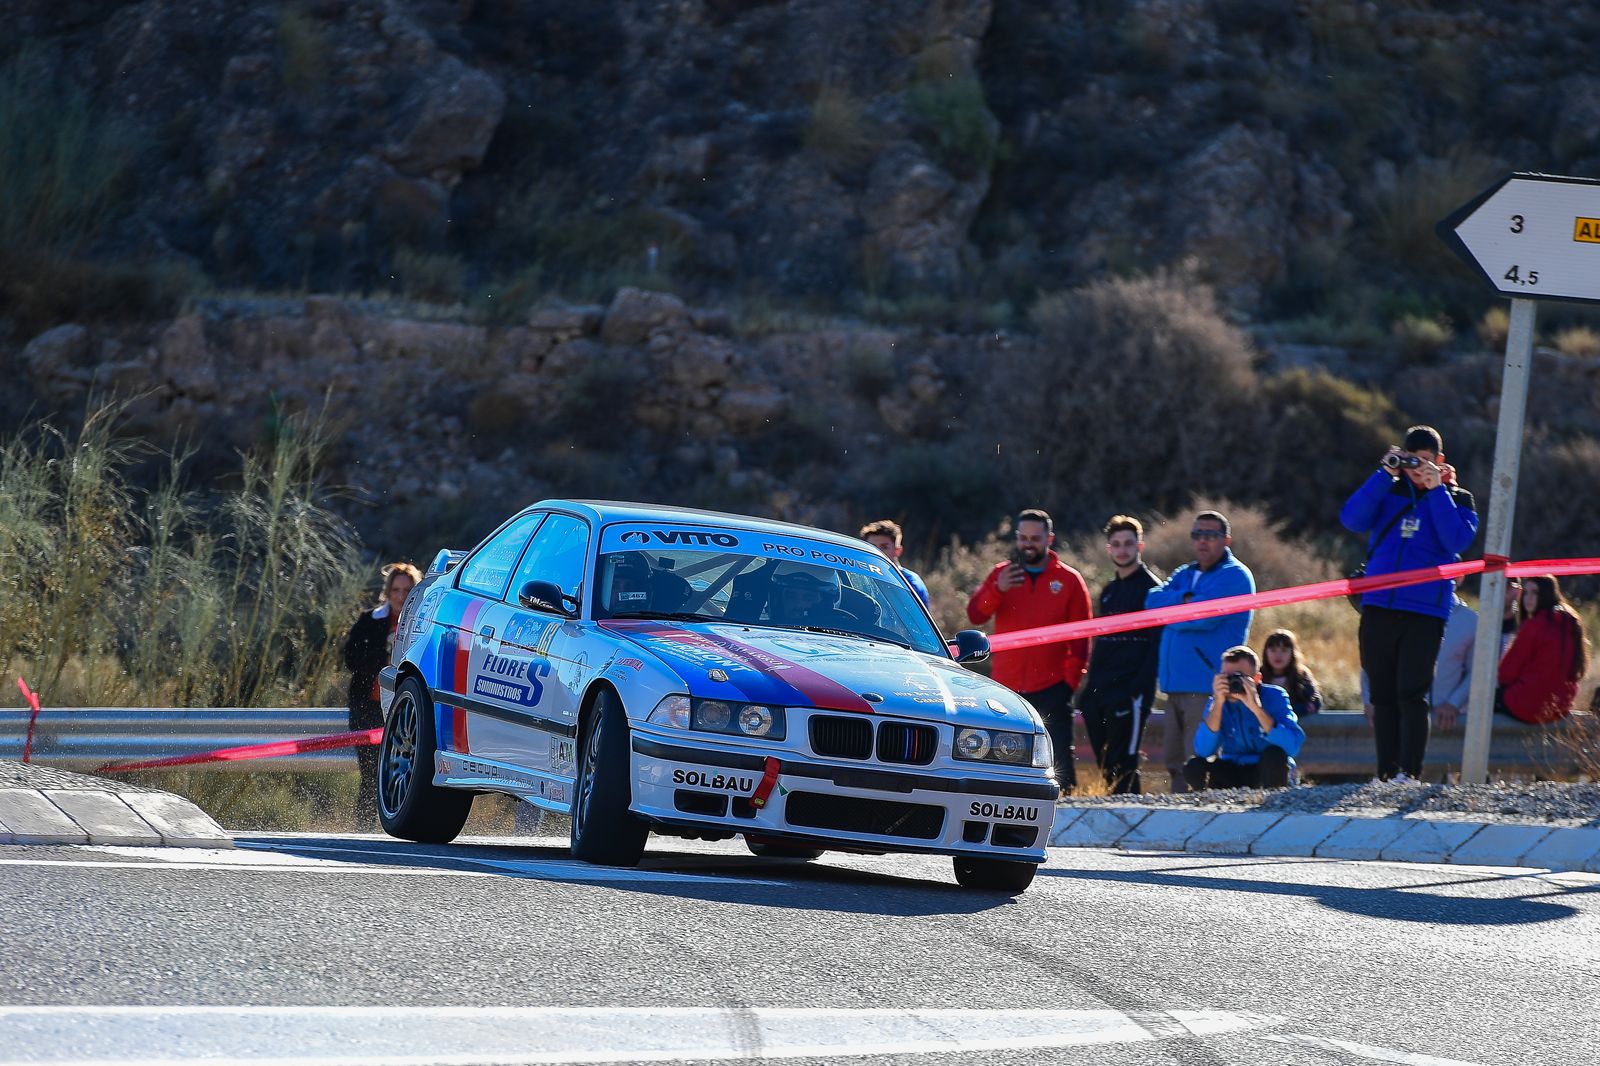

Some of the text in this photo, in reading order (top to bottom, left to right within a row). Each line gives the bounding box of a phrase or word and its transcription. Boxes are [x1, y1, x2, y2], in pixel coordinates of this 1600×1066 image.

[1510, 214, 1525, 234] 3
[1503, 264, 1539, 286] 4,5
[651, 530, 886, 576] VITO PRO POWER
[476, 679, 522, 701] SUMINISTROS
[482, 653, 551, 707] FLORES
[672, 769, 753, 792] SOLBAU
[969, 801, 1039, 821] SOLBAU
